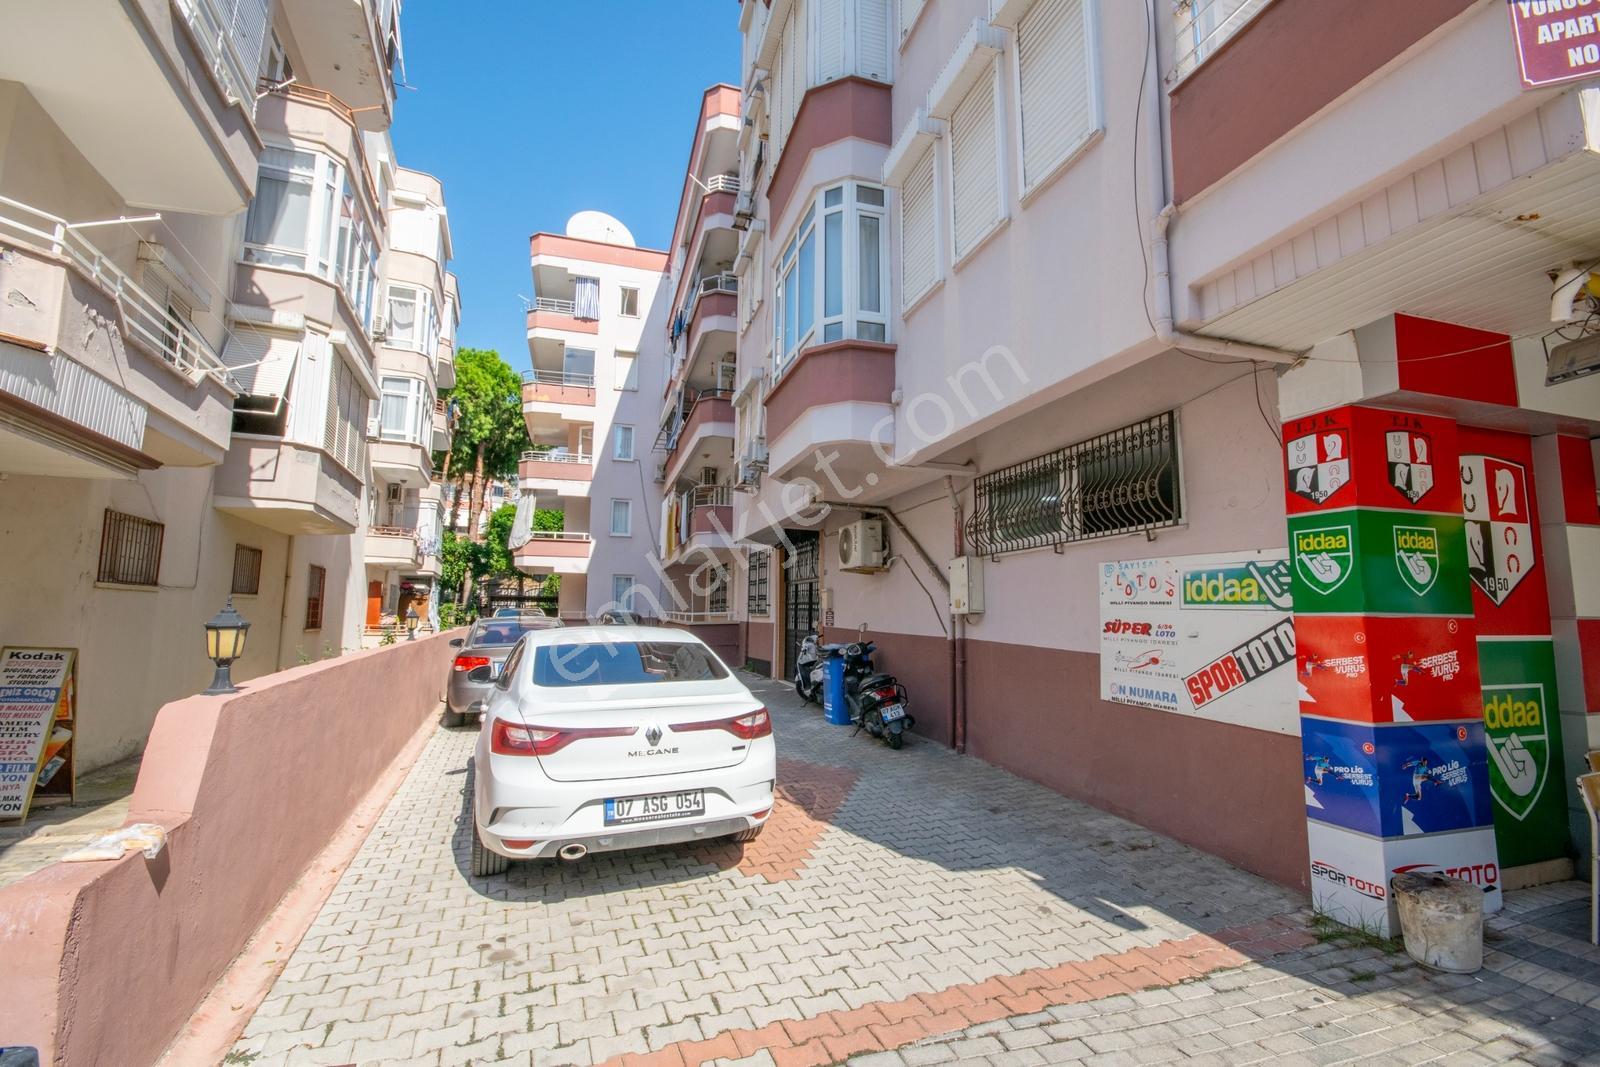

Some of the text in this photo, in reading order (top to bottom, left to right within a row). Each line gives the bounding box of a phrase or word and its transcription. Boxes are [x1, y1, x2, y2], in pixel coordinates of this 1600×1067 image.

[1568, 43, 1600, 68] NO
[1311, 489, 1328, 500] 1950
[1406, 489, 1420, 499] 1950
[1298, 532, 1347, 552] iddaa
[1397, 530, 1435, 550] iddaa
[1116, 574, 1158, 596] LOTO
[1185, 572, 1259, 603] iddaa
[1482, 576, 1509, 592] 1950
[1103, 618, 1153, 637] SÜPER
[1155, 630, 1176, 638] LOTO
[9, 651, 65, 661] Kodak
[1325, 655, 1365, 667] SERBEST
[1420, 650, 1459, 669] SERBEST
[1442, 673, 1454, 682] PRO
[24, 688, 56, 701] COLOR
[1129, 686, 1178, 705] NUMARA
[1484, 694, 1541, 729] ddaa
[6, 763, 31, 773] FILM
[1432, 764, 1448, 777] PRO
[1442, 766, 1468, 781] SERBEST
[1, 774, 27, 782] YON
[1343, 772, 1373, 780] SERBEST
[0, 783, 20, 792] NYA
[616, 799, 634, 817] 07
[642, 795, 668, 814] ASG
[675, 791, 701, 810] 054
[1311, 864, 1386, 898] SPORTOTO
